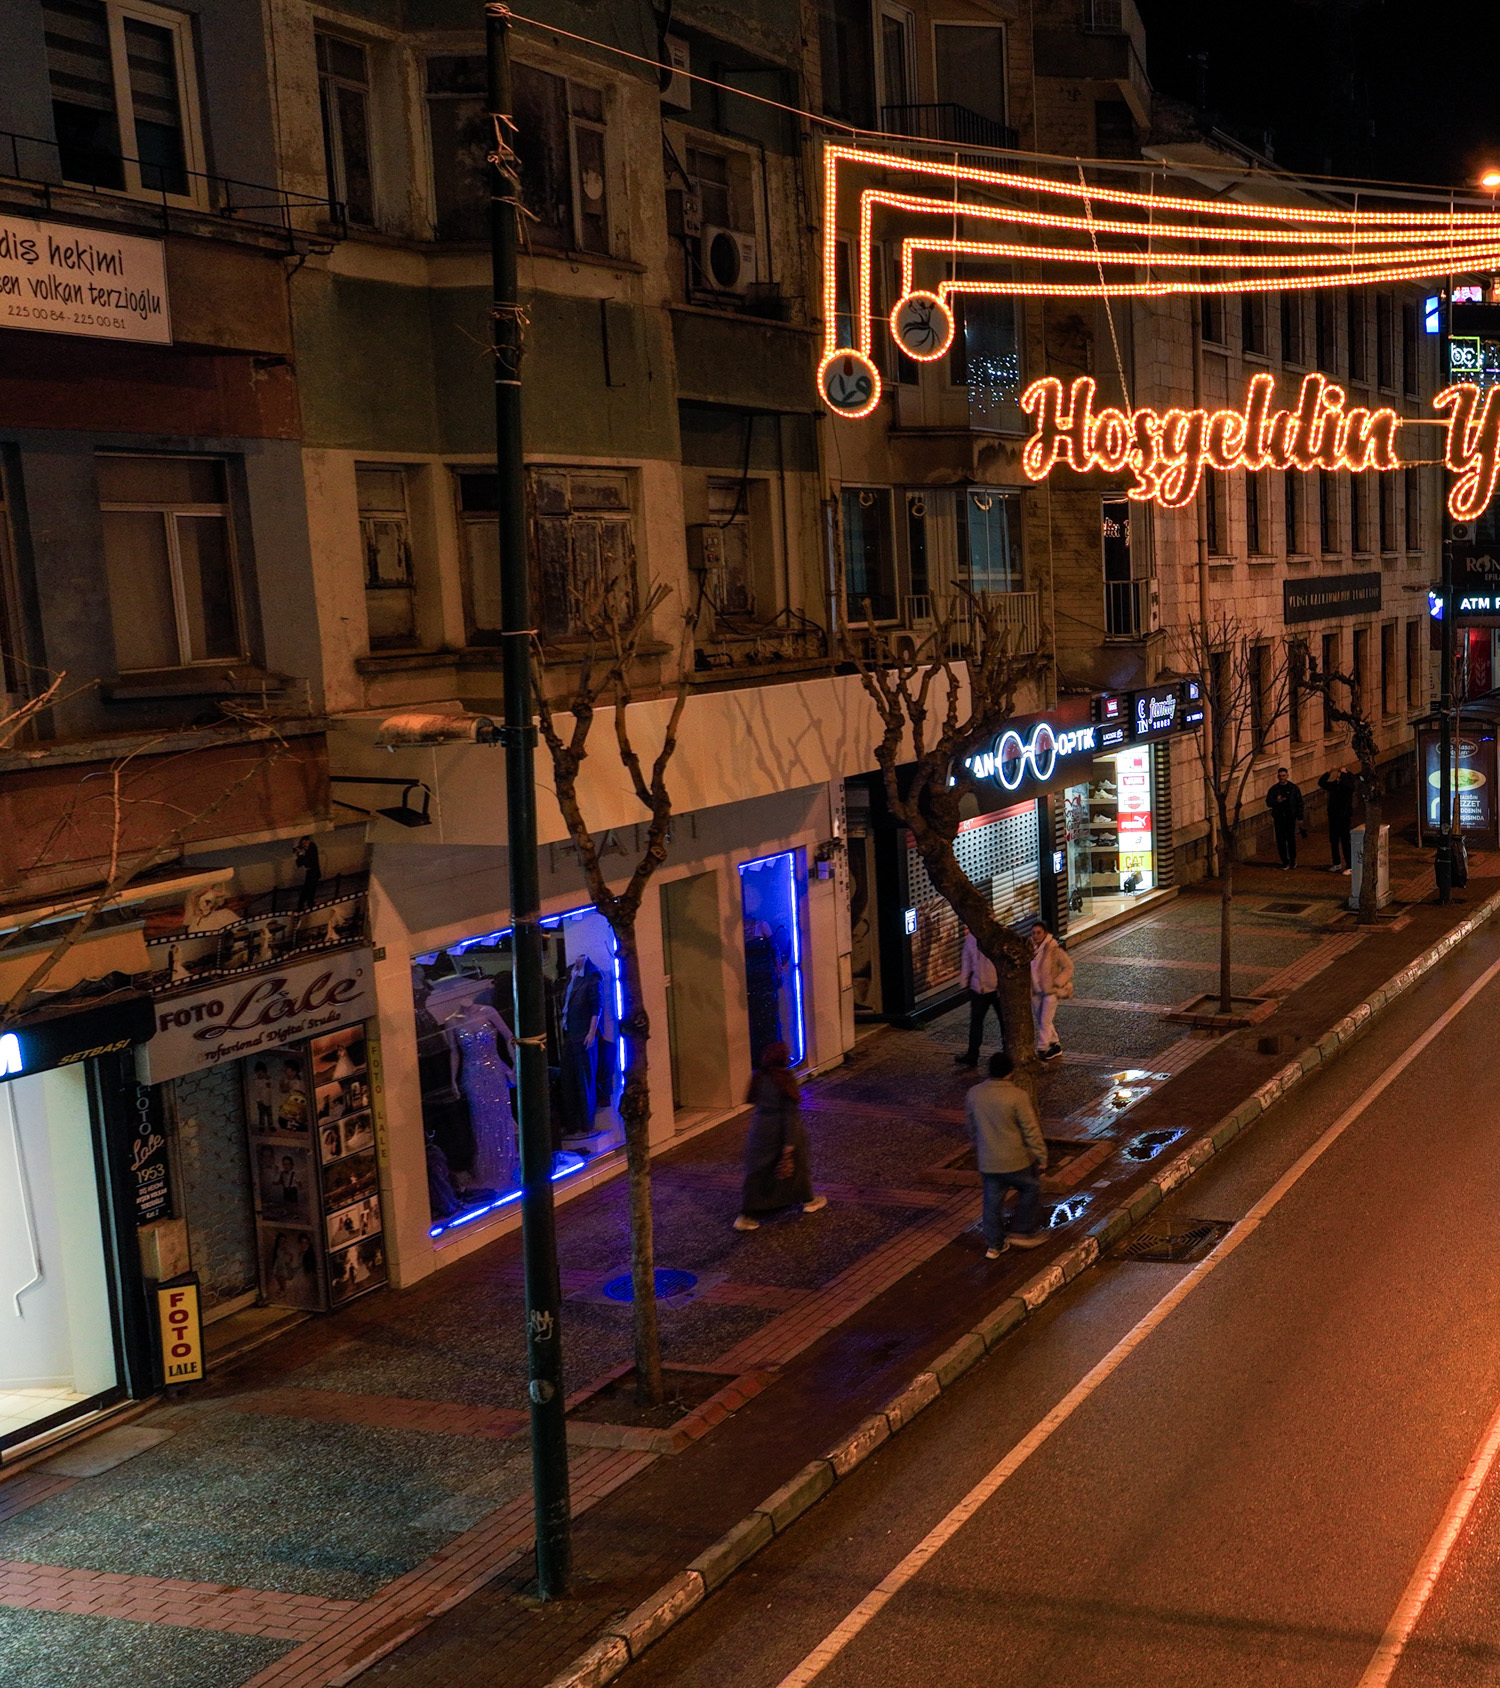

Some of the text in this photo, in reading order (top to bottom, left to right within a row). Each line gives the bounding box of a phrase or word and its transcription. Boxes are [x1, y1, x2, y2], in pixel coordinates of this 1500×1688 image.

[0, 229, 124, 276] diş hekimi
[0, 274, 162, 320] en volkan terzioğlu
[8, 304, 31, 318] 225
[74, 312, 95, 326] 225
[1021, 371, 1399, 509] Hoşgeldin
[1460, 597, 1490, 610] ATM
[159, 999, 225, 1033] FOTO
[266, 1020, 304, 1042] Digital
[308, 1010, 341, 1030] Studio
[136, 1163, 165, 1184] 1953
[169, 1291, 192, 1358] FOTO
[168, 1361, 198, 1377] LALE
